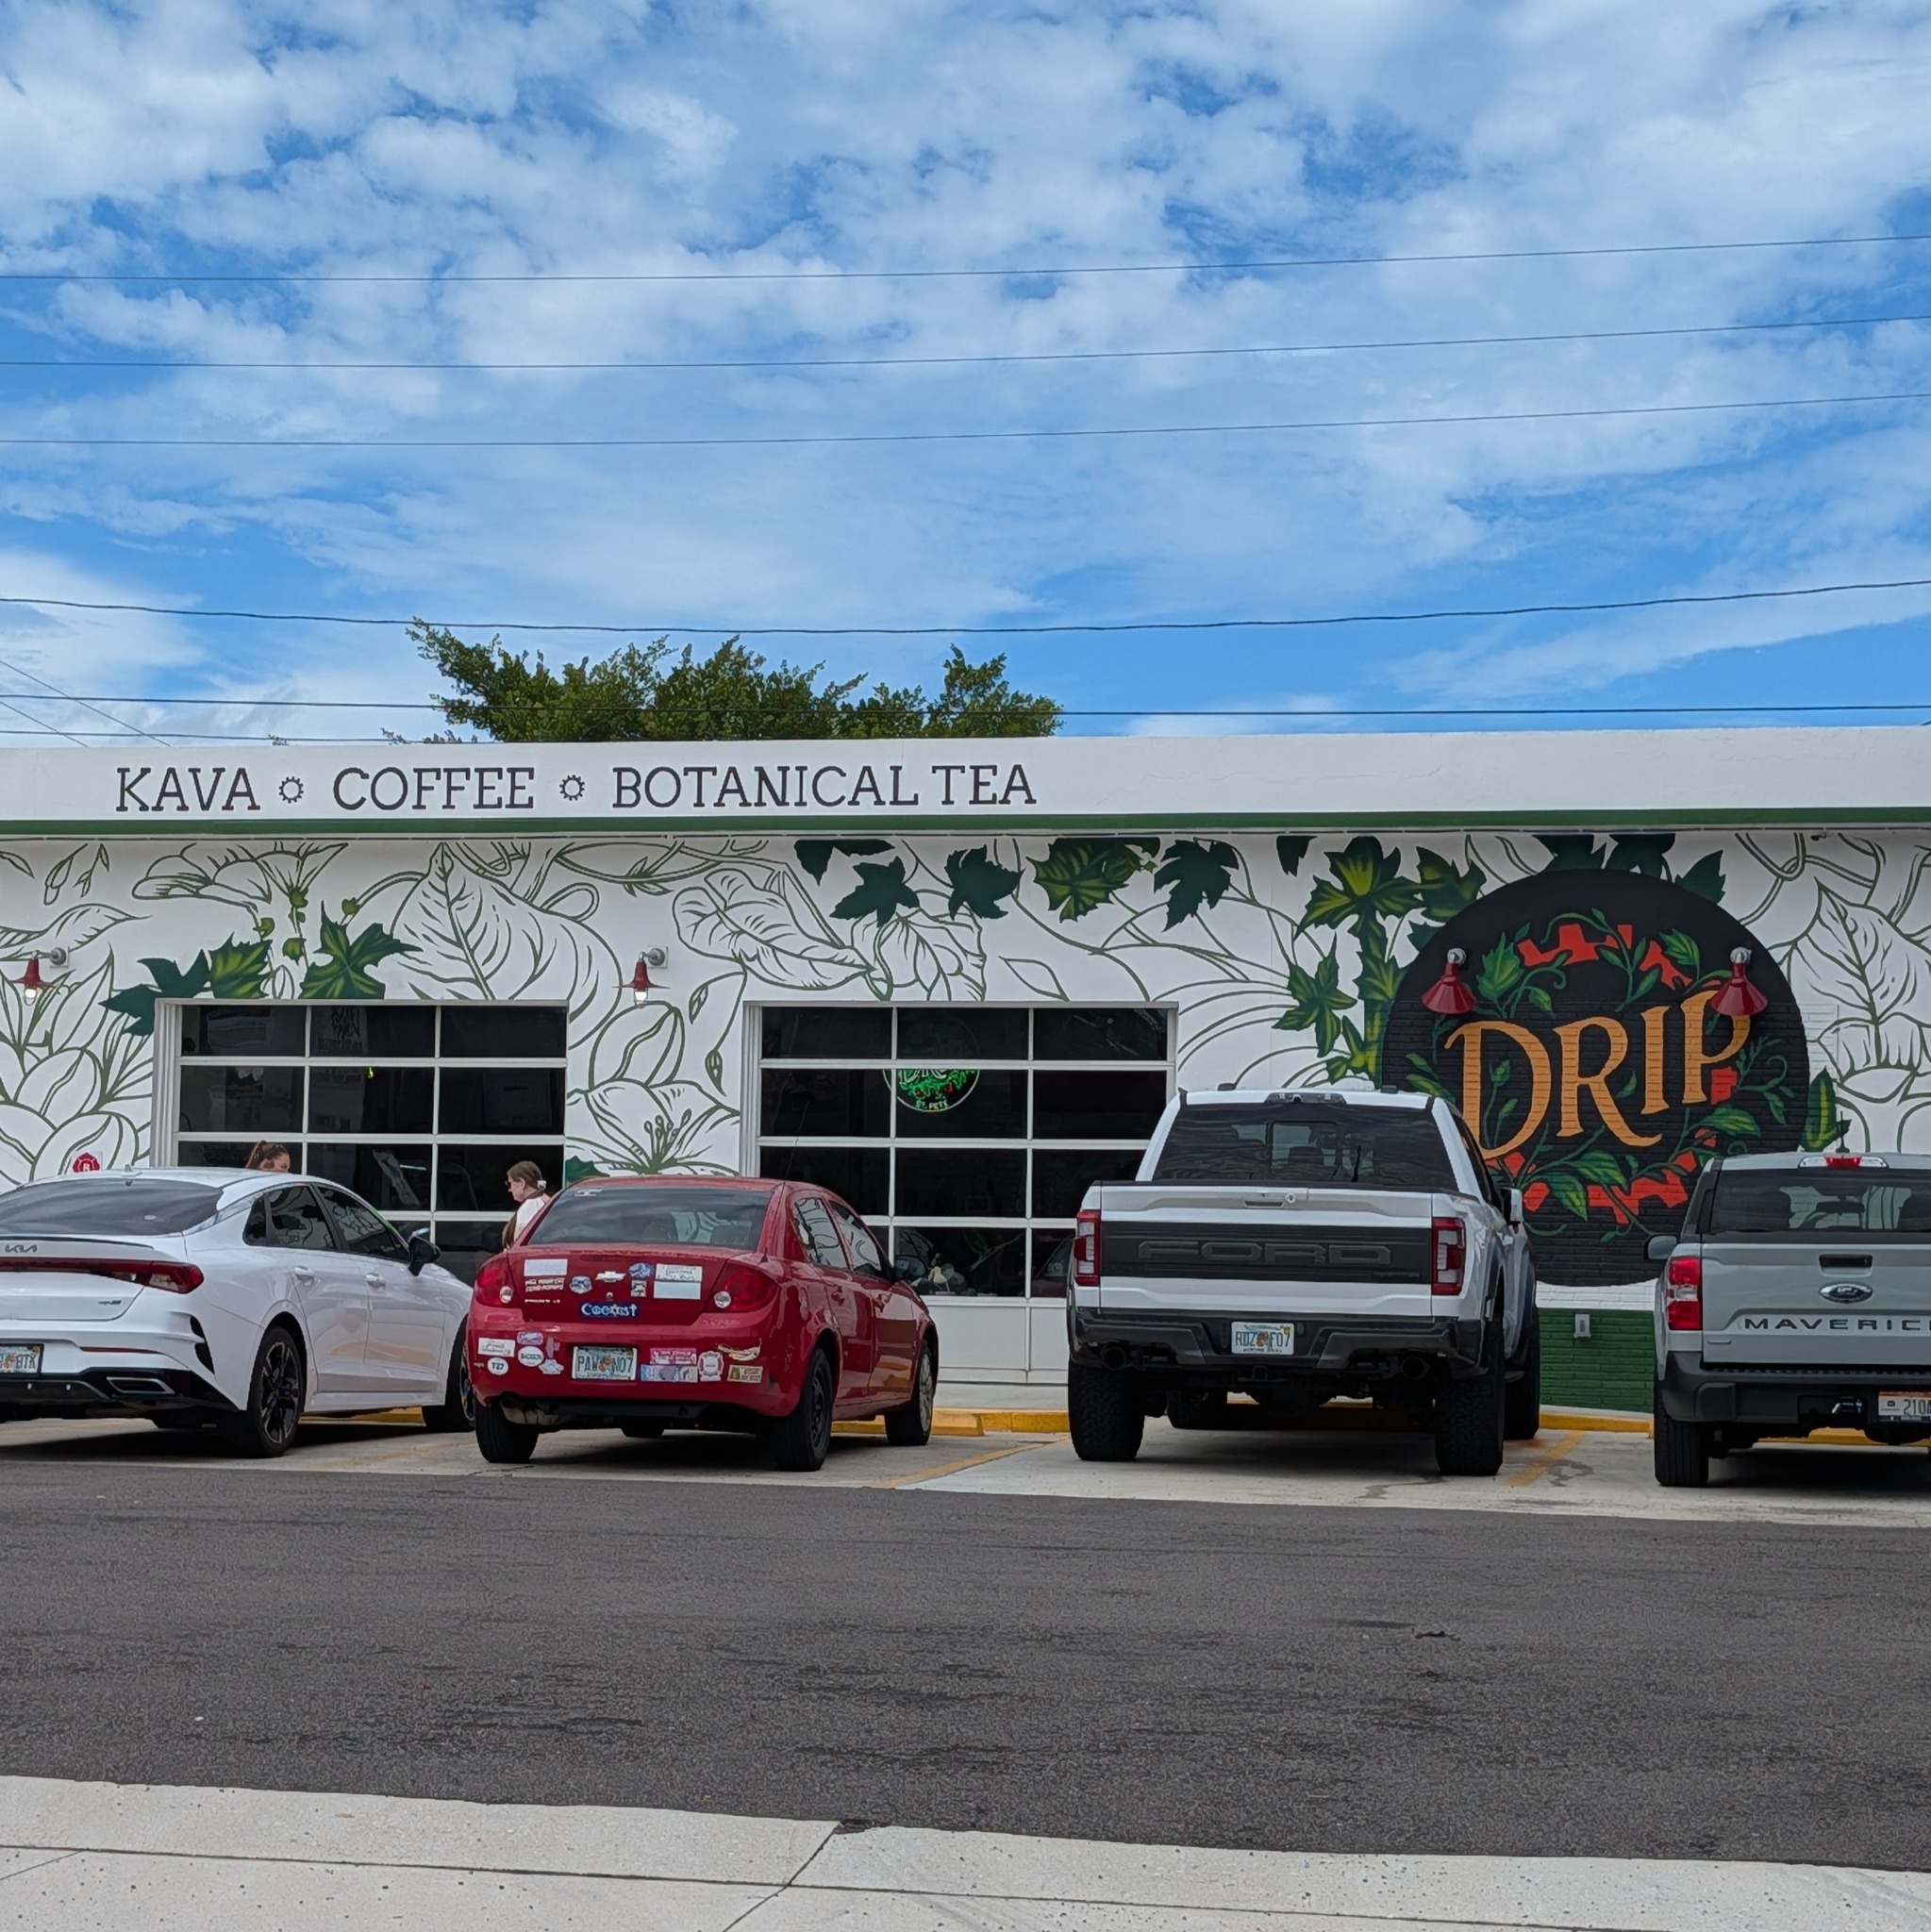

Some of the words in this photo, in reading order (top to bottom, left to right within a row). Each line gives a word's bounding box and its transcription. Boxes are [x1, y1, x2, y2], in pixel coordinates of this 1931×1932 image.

[115, 767, 261, 811] KAVA
[333, 766, 536, 811] COFFEE
[612, 765, 919, 808] BOTANICAL
[931, 764, 1037, 805] TEA
[1444, 991, 1751, 1160] DRIP
[1138, 1241, 1392, 1266] FORD
[1744, 1318, 1931, 1330] MAVERIC
